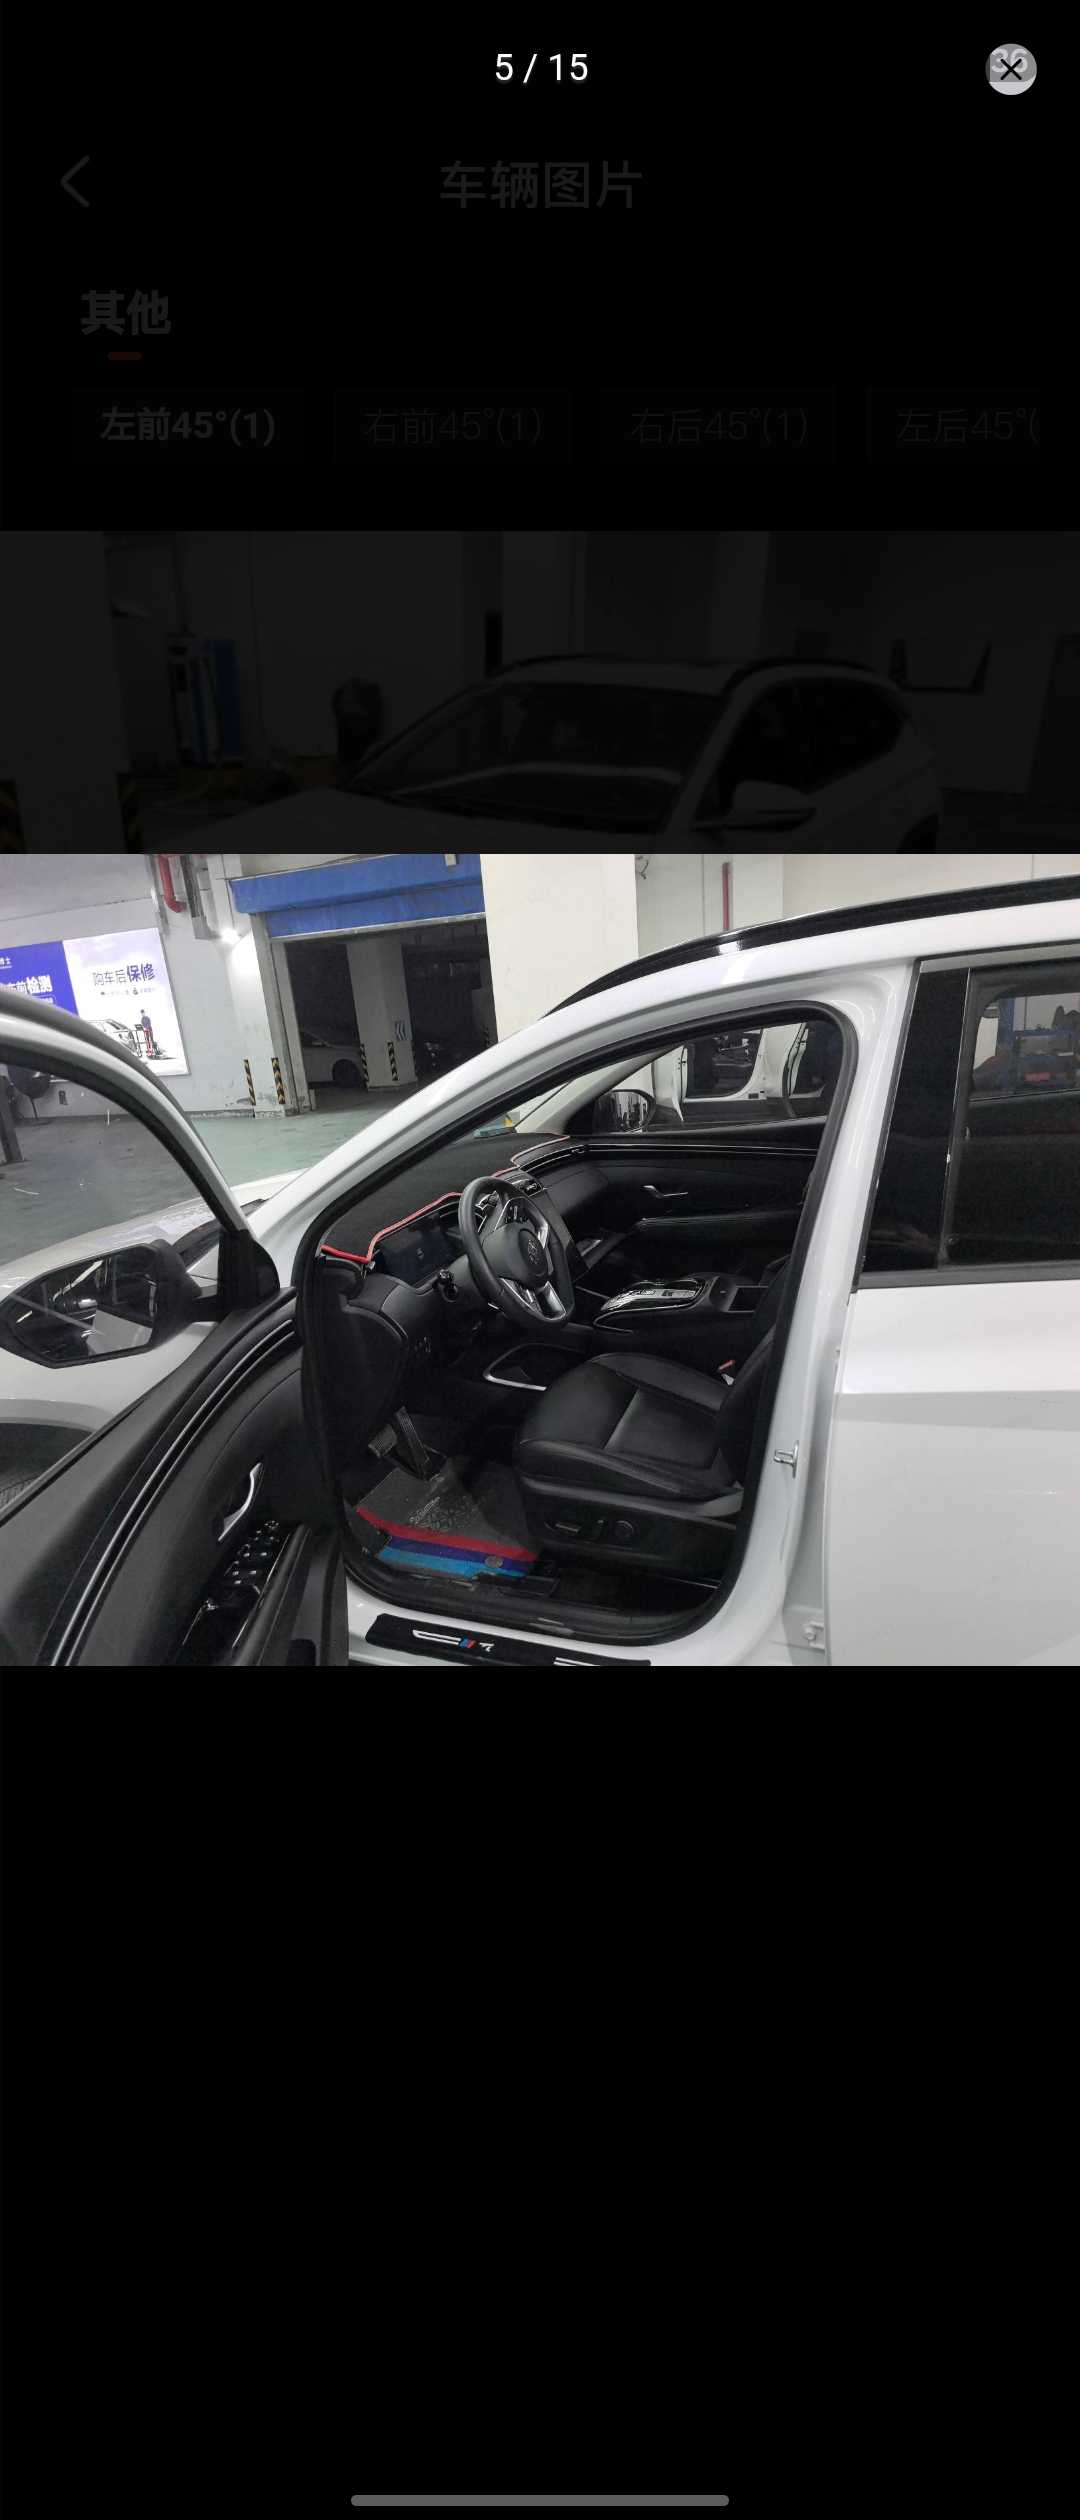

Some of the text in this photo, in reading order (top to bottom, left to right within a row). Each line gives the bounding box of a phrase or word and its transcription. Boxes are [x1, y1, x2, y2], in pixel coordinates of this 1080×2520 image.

[92, 963, 155, 986] 购车后保修
